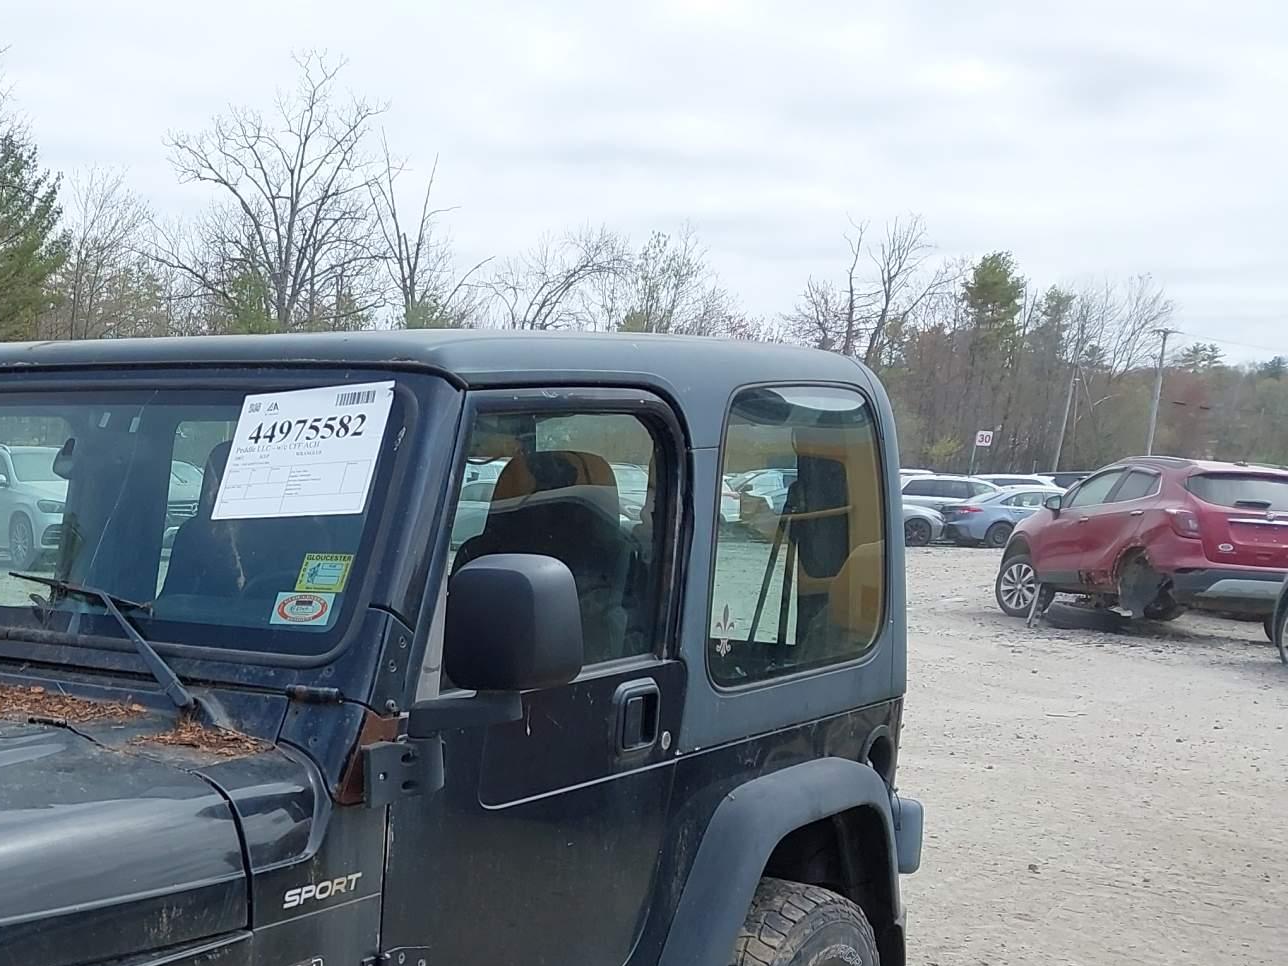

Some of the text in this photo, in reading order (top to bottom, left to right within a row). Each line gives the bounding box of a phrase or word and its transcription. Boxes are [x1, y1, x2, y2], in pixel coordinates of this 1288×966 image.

[248, 412, 367, 445] 44975582
[977, 434, 992, 444] 30
[306, 554, 352, 562] GLOUCESTER
[283, 872, 363, 909] SPORT
